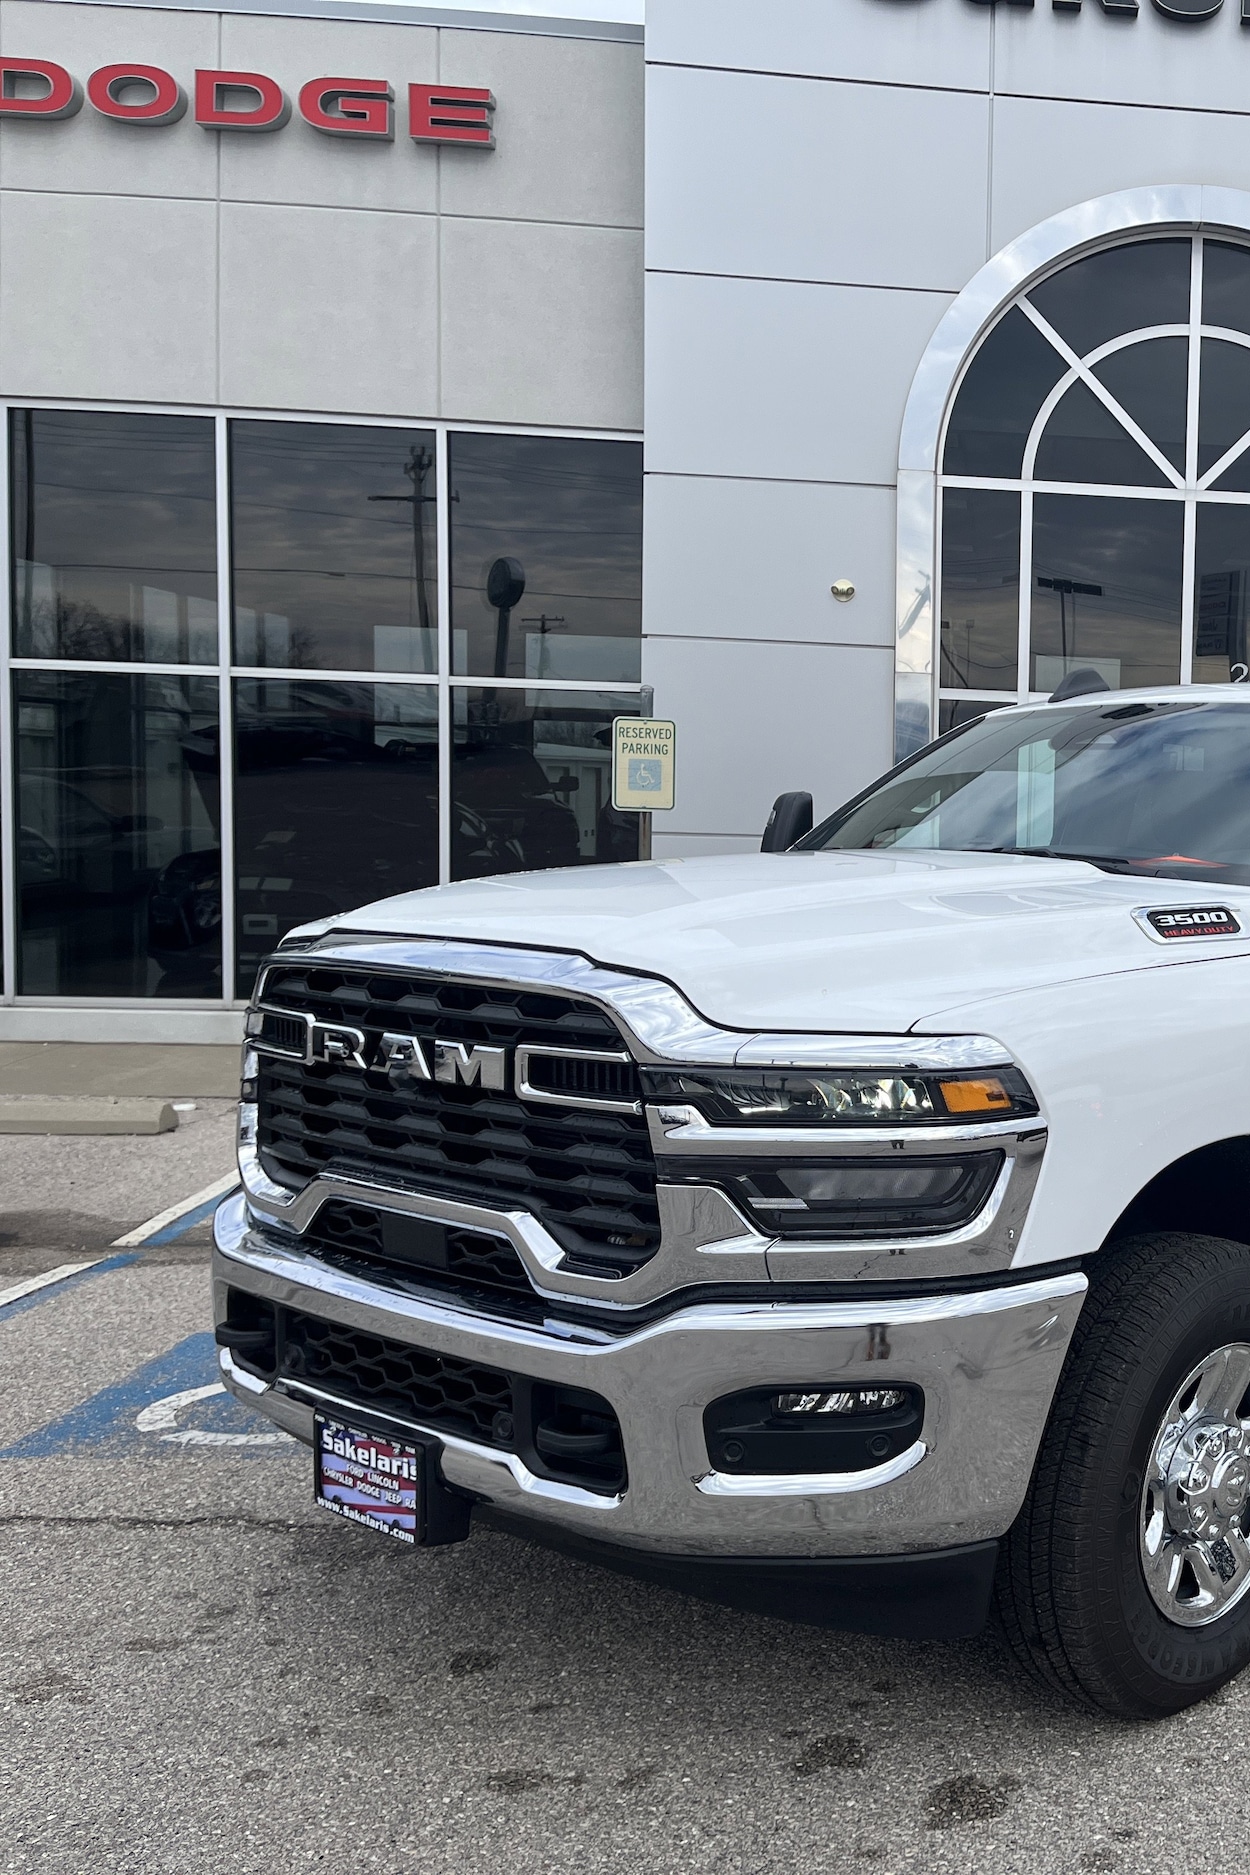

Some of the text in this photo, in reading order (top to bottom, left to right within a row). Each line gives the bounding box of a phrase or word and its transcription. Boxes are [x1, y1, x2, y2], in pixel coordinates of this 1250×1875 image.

[0, 56, 496, 150] DODGE
[618, 726, 672, 740] RESERVED
[622, 742, 669, 756] PARKING
[1155, 911, 1229, 927] 3500
[1164, 926, 1234, 937] HEAVY DUTY
[312, 1021, 505, 1091] RAM
[322, 1428, 417, 1481] Sakelaris
[323, 1466, 354, 1487] CHRYSLER
[356, 1480, 380, 1498] DODGE
[384, 1490, 402, 1505] JEEP
[346, 1463, 399, 1491] FORD LINCOLN
[317, 1496, 415, 1544] www.Sakelaris.com
